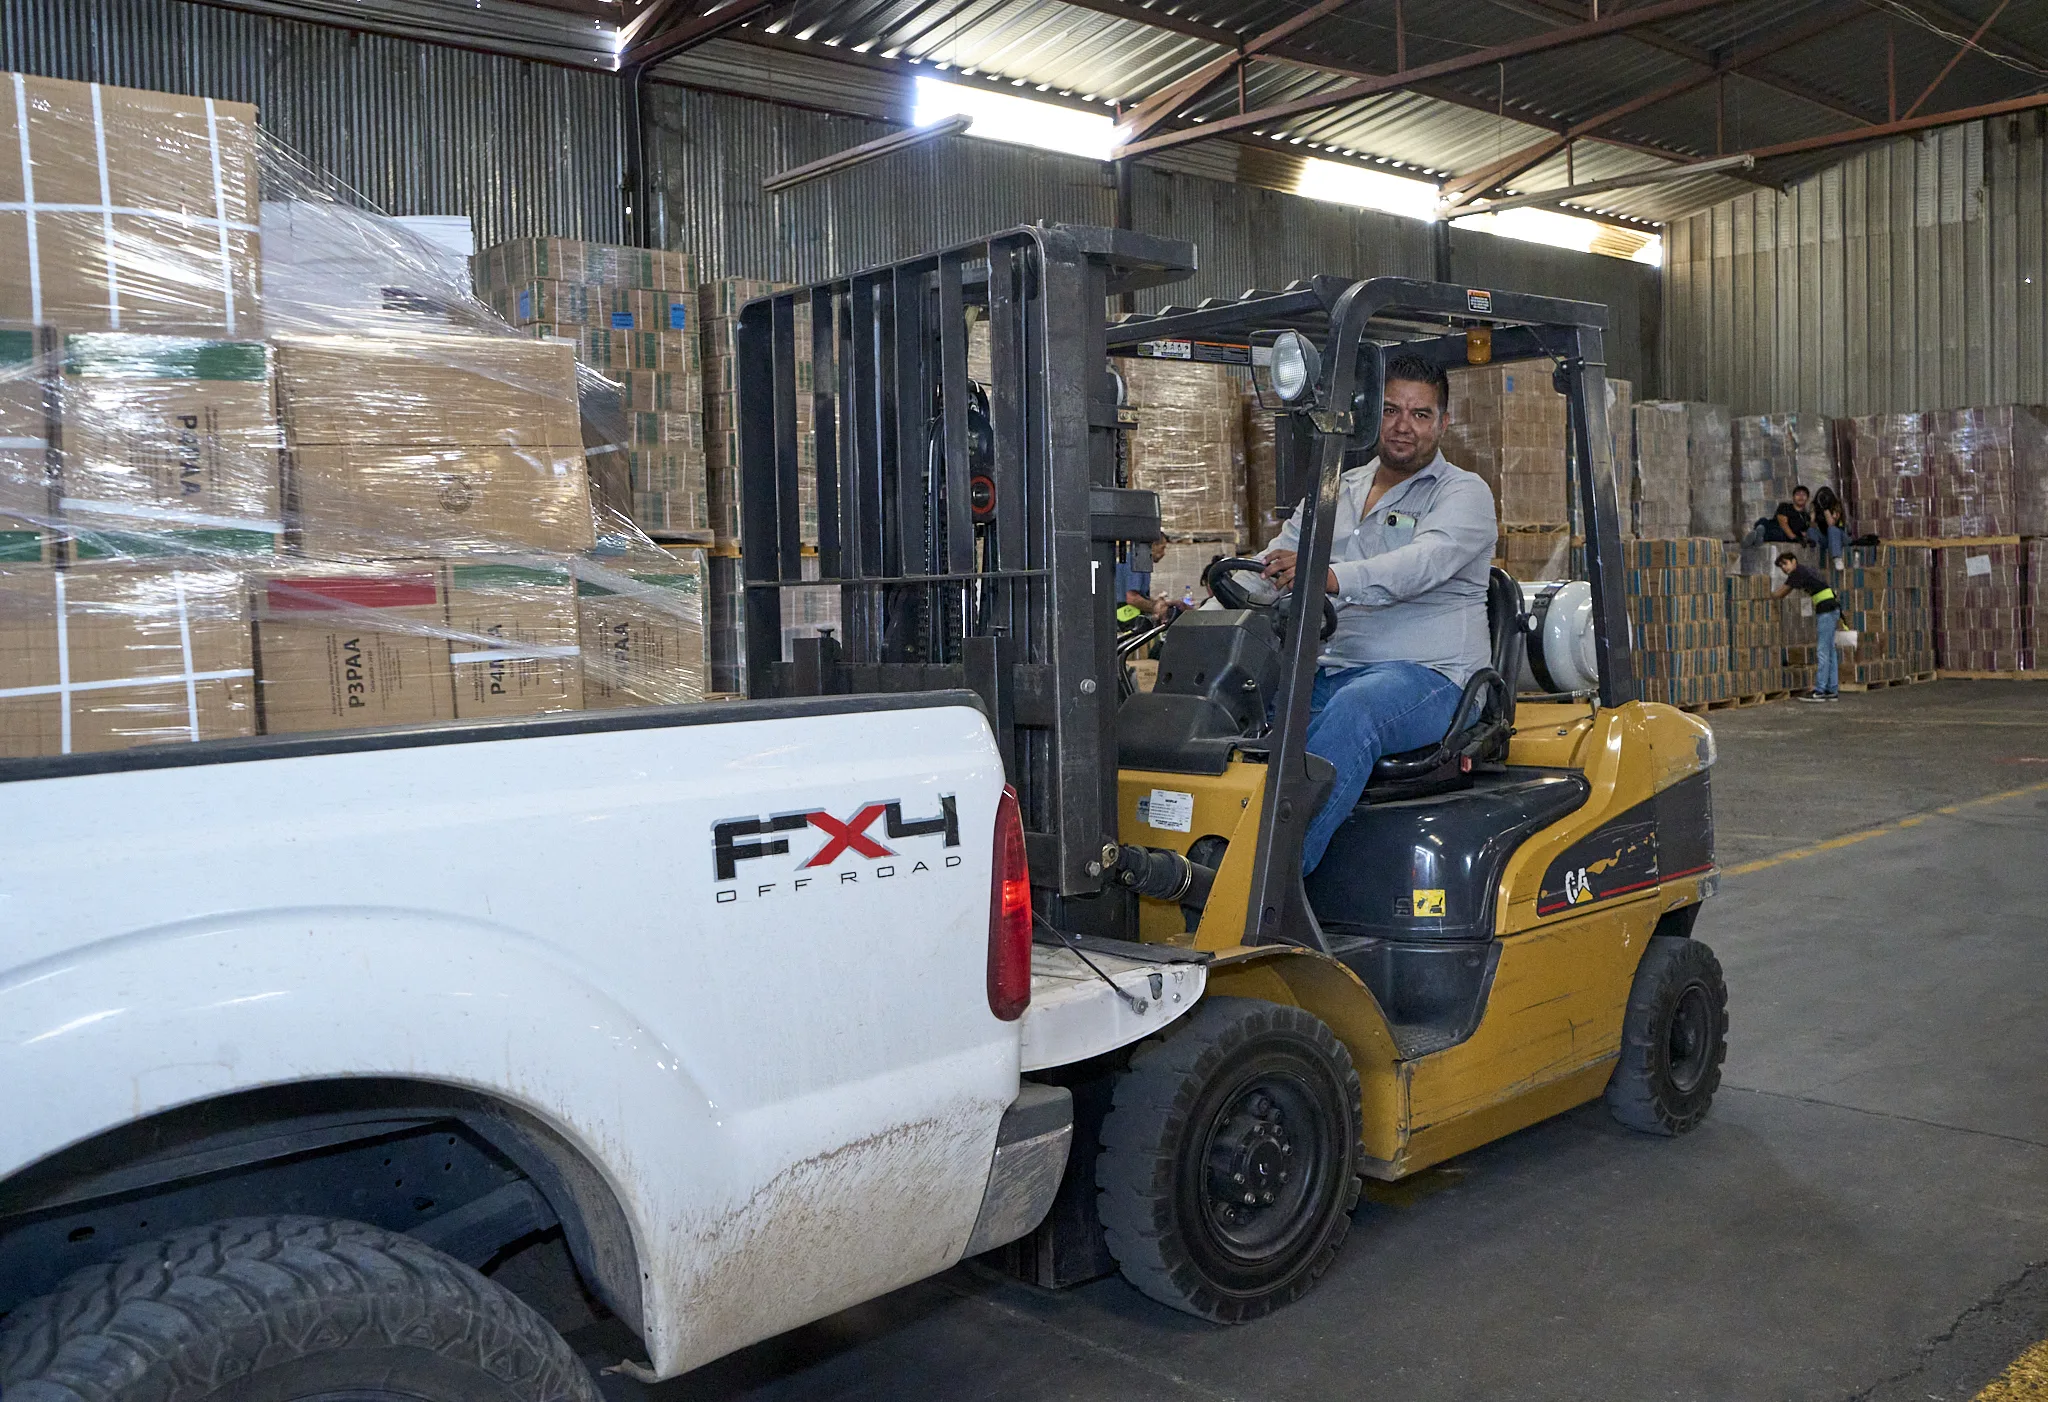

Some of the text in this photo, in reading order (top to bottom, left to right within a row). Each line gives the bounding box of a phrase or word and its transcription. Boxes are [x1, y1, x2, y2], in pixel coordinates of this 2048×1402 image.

[344, 637, 366, 708] P3PAA
[711, 791, 961, 881] FX4
[715, 855, 962, 904] OFF ROAD
